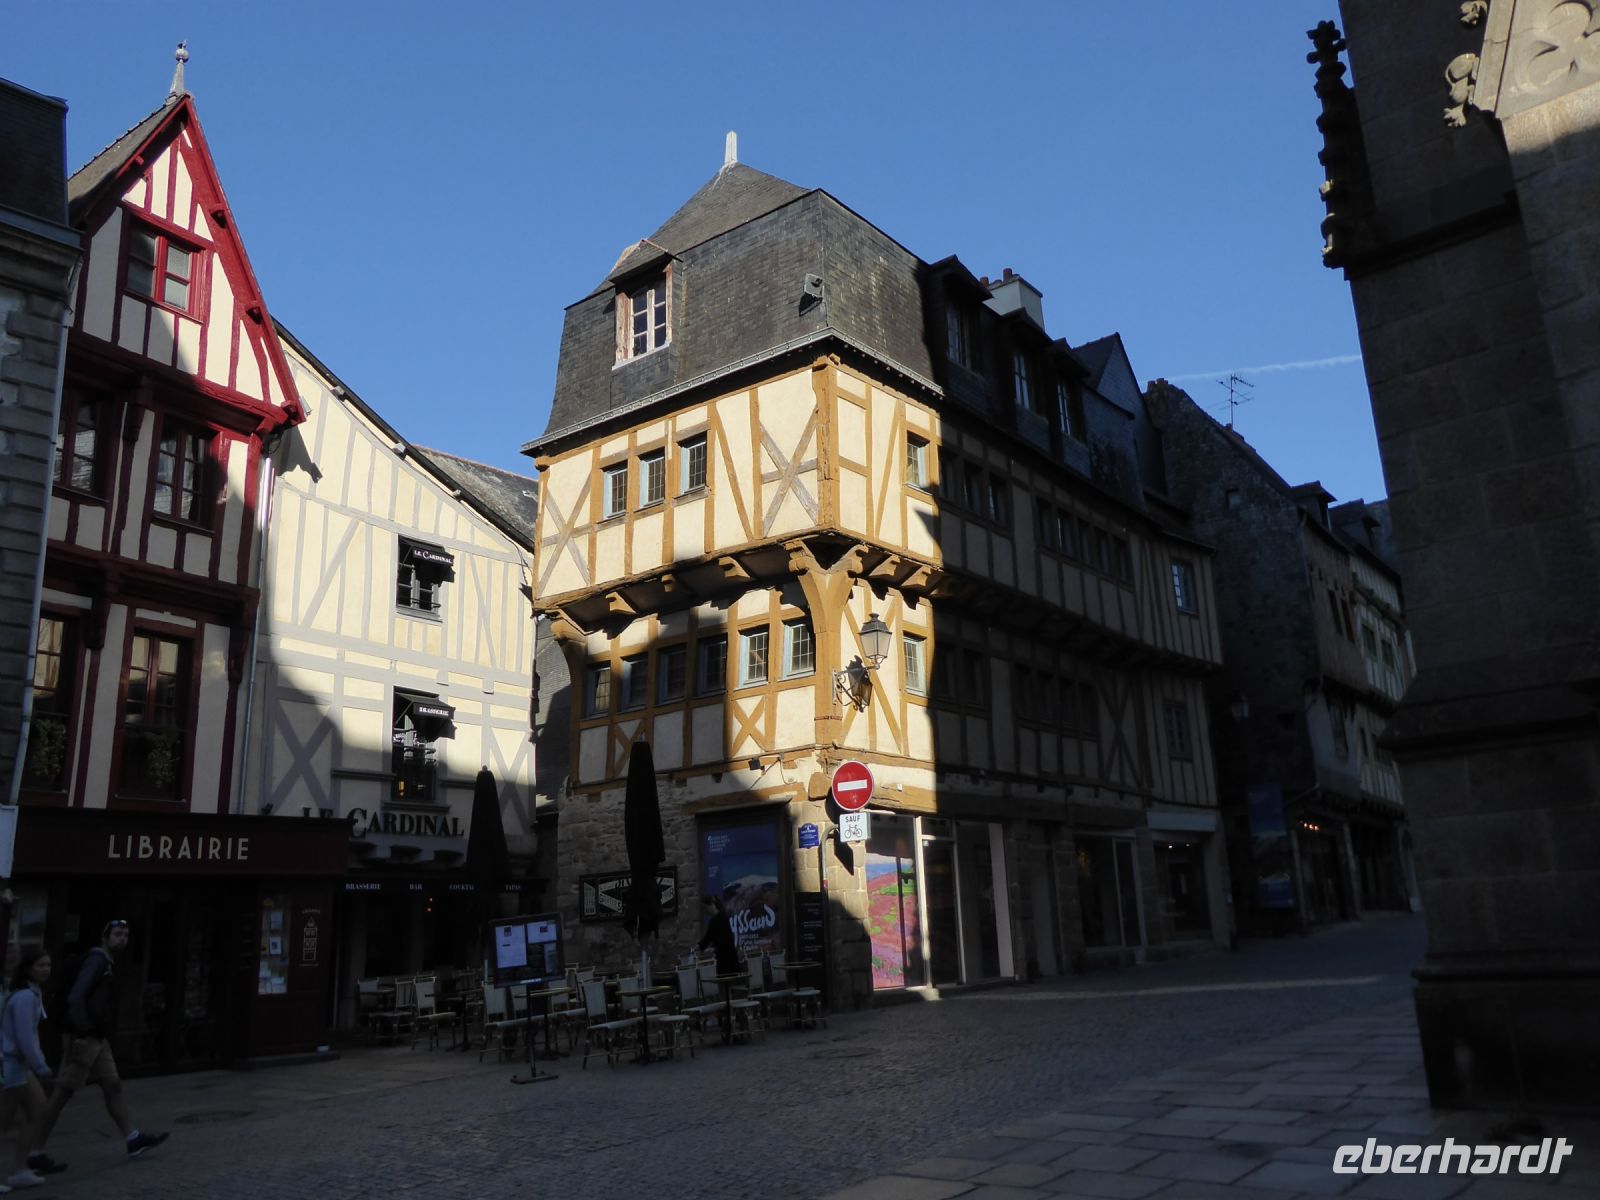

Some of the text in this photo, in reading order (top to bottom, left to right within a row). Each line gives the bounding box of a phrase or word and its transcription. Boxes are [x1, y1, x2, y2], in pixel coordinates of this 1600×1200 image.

[347, 807, 465, 838] CARDINAL
[845, 815, 861, 823] SAUF
[108, 834, 249, 860] LIBRAIRIE
[345, 882, 382, 891] BRASSERIE
[408, 882, 423, 891] BAR
[503, 883, 522, 891] TAPAS
